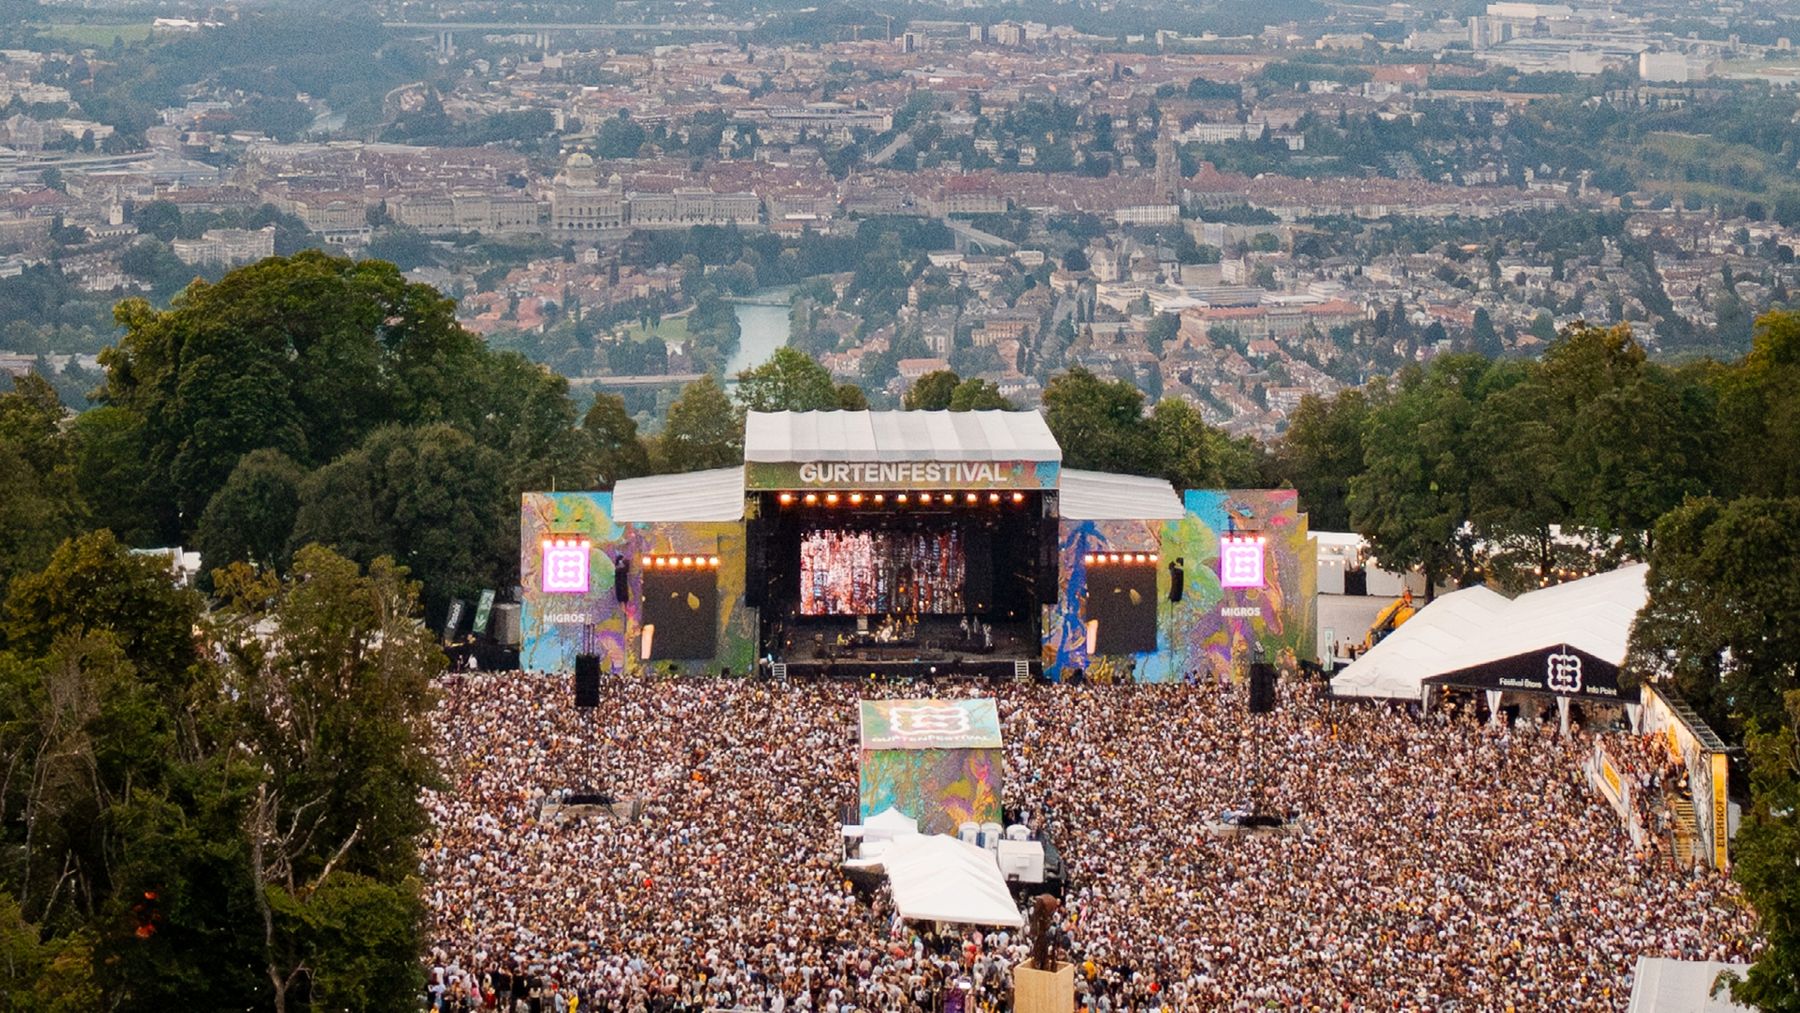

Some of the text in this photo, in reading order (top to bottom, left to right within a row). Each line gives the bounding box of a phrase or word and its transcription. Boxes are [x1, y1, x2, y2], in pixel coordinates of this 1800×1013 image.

[799, 463, 1008, 483] GURTENFESTIVAL
[543, 613, 585, 624] MIGROS
[1221, 607, 1261, 617] MIGROS
[1716, 798, 1725, 848] EICHHOF
